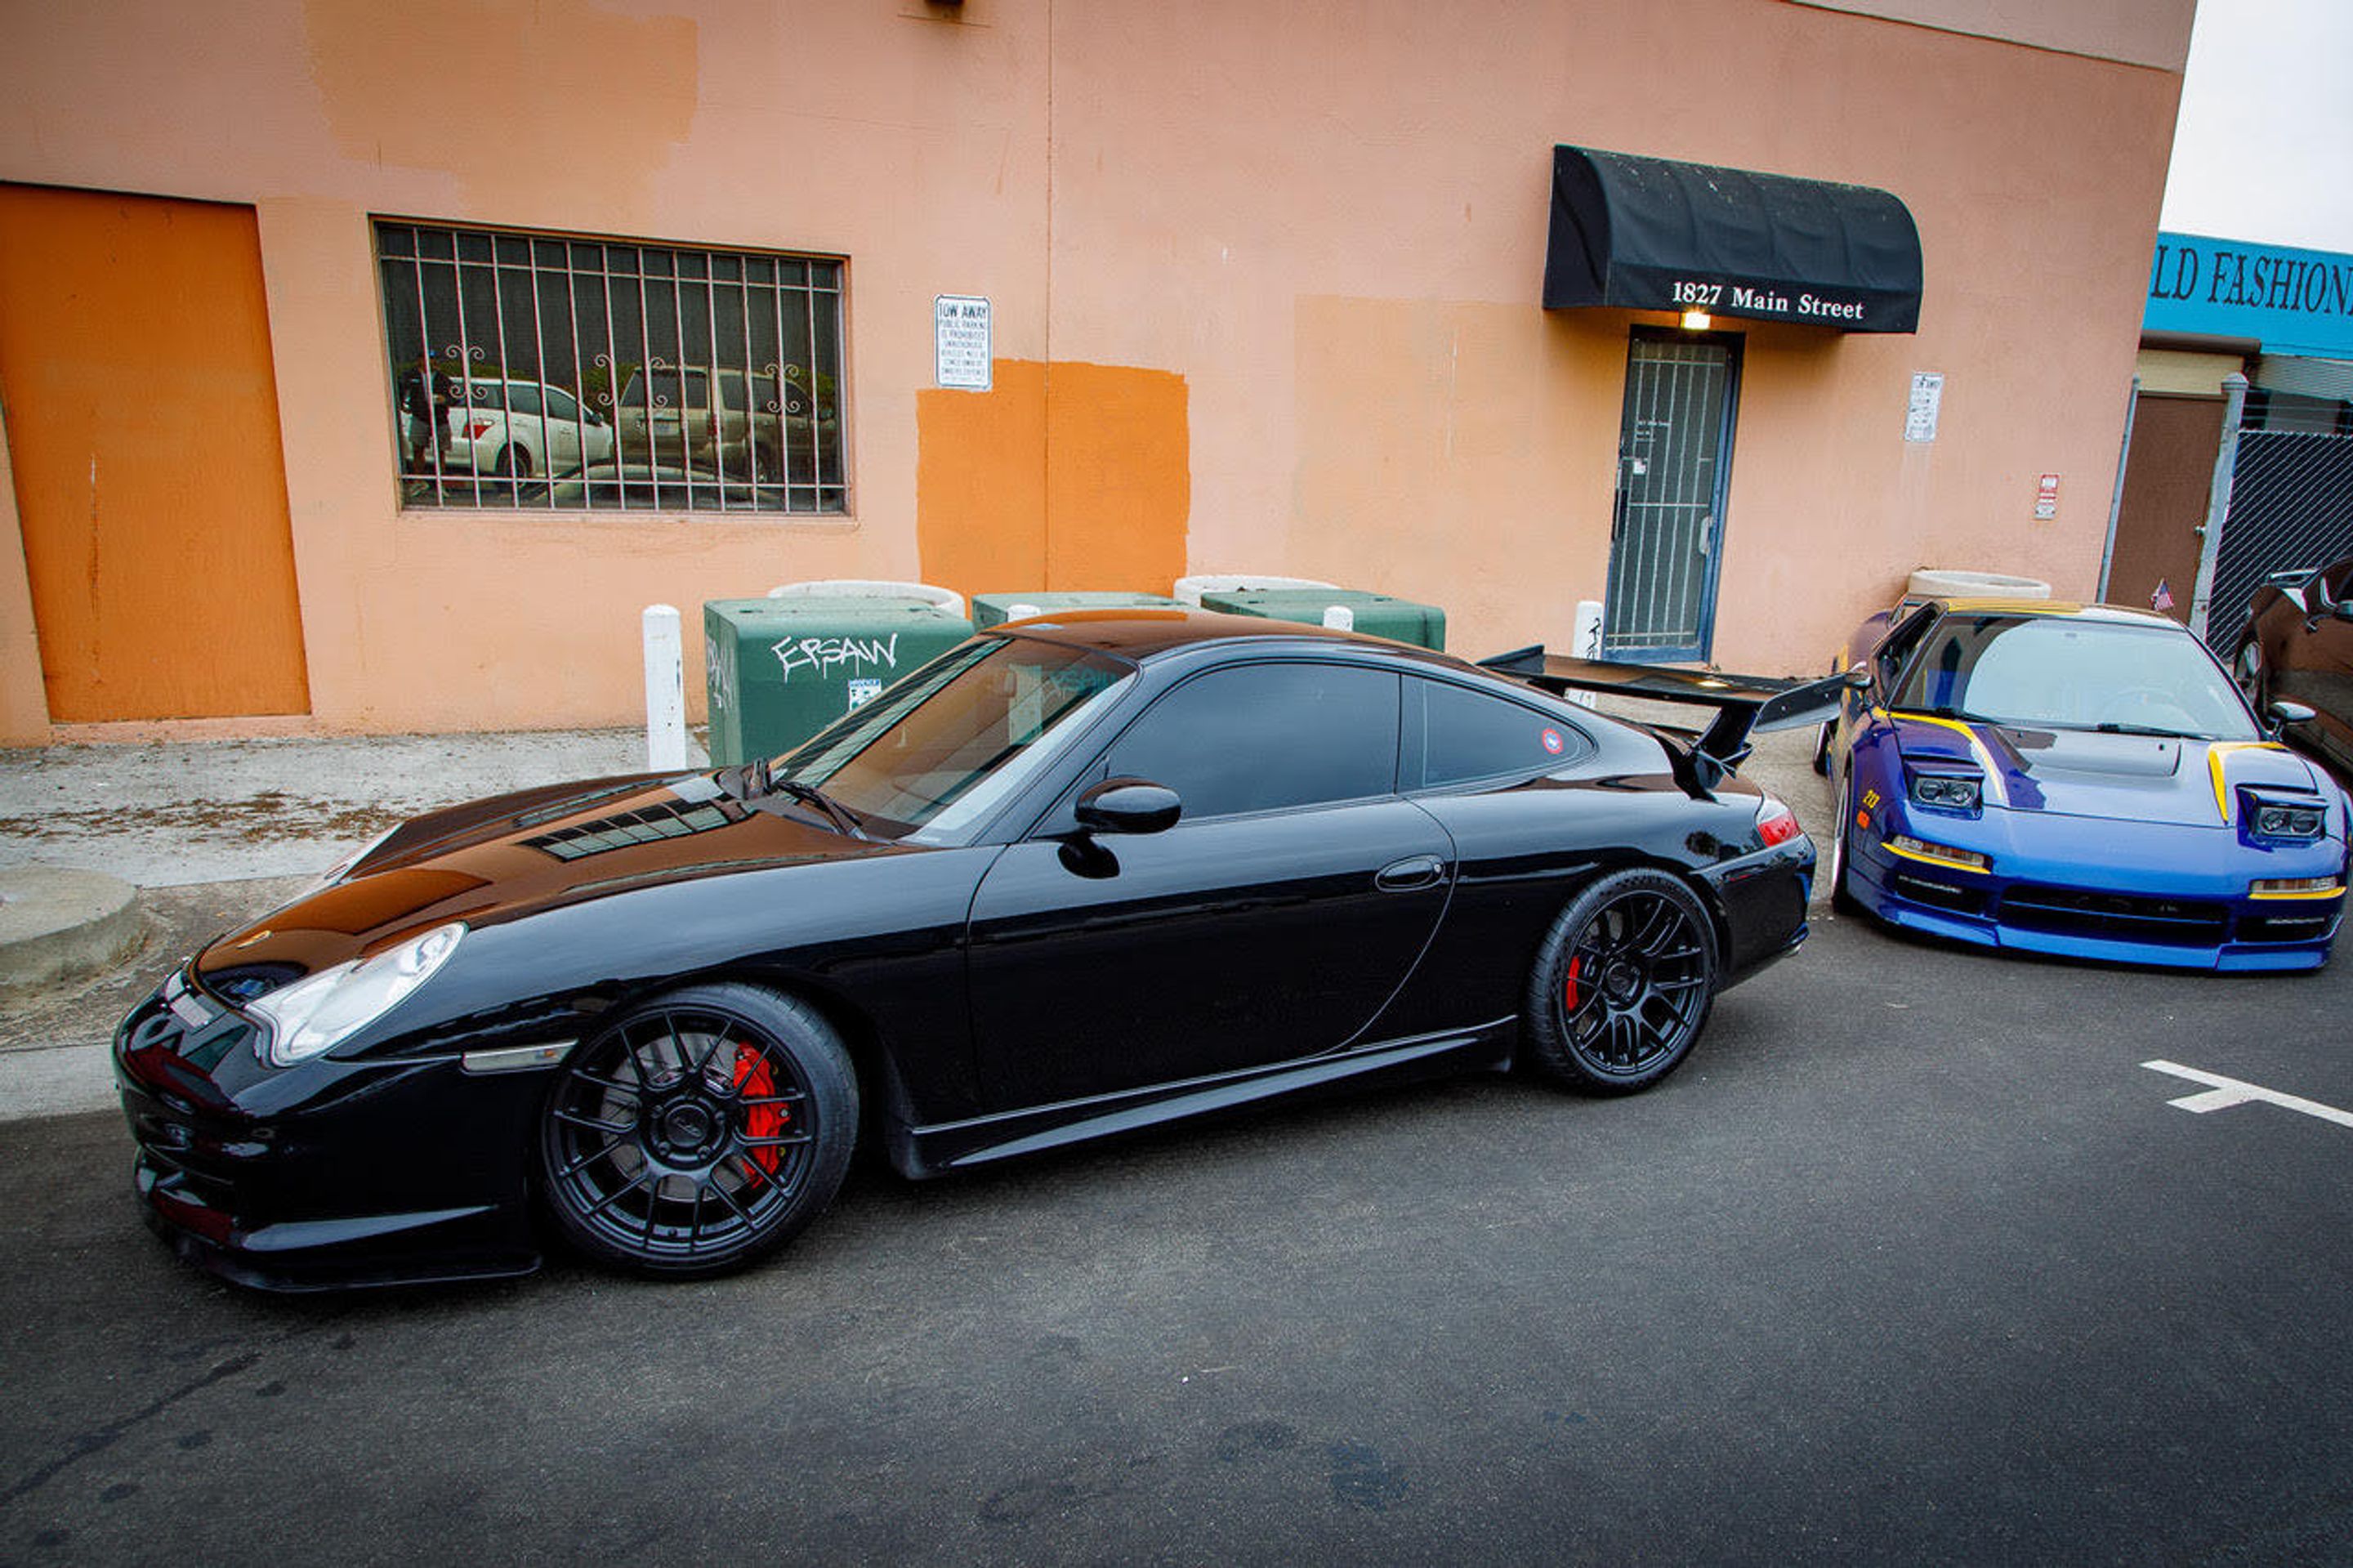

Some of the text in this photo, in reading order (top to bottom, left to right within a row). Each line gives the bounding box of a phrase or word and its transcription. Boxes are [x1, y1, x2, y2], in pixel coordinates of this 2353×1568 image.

[939, 302, 986, 319] TOW AWAY
[1672, 281, 1864, 319] 1827 Main Street
